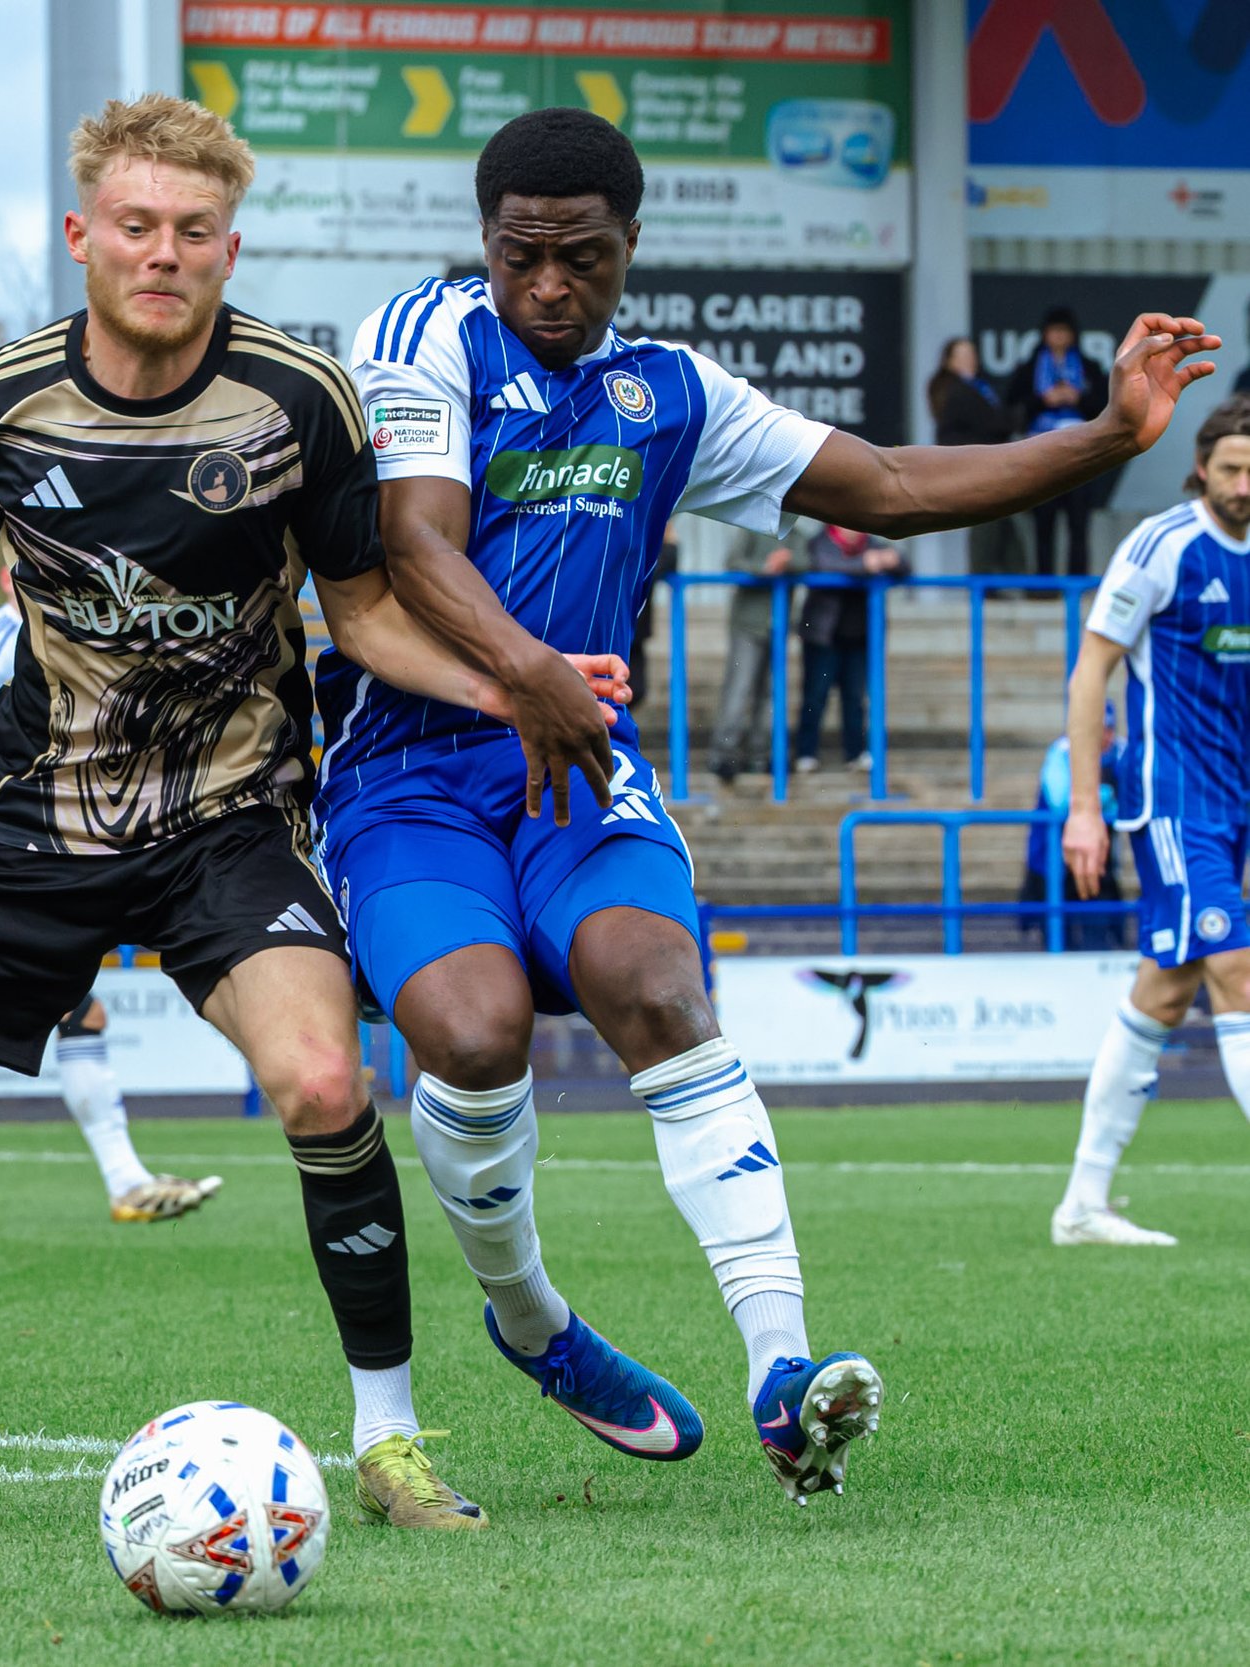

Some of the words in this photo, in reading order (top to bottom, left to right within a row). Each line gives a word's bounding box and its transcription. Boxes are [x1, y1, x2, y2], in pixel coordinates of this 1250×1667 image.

[614, 291, 696, 331] OUR
[700, 293, 863, 334] CAREER
[772, 340, 866, 380] AND
[376, 409, 440, 420] enterprise
[394, 428, 441, 437] NATIONAL
[398, 435, 435, 444] LEAGUE
